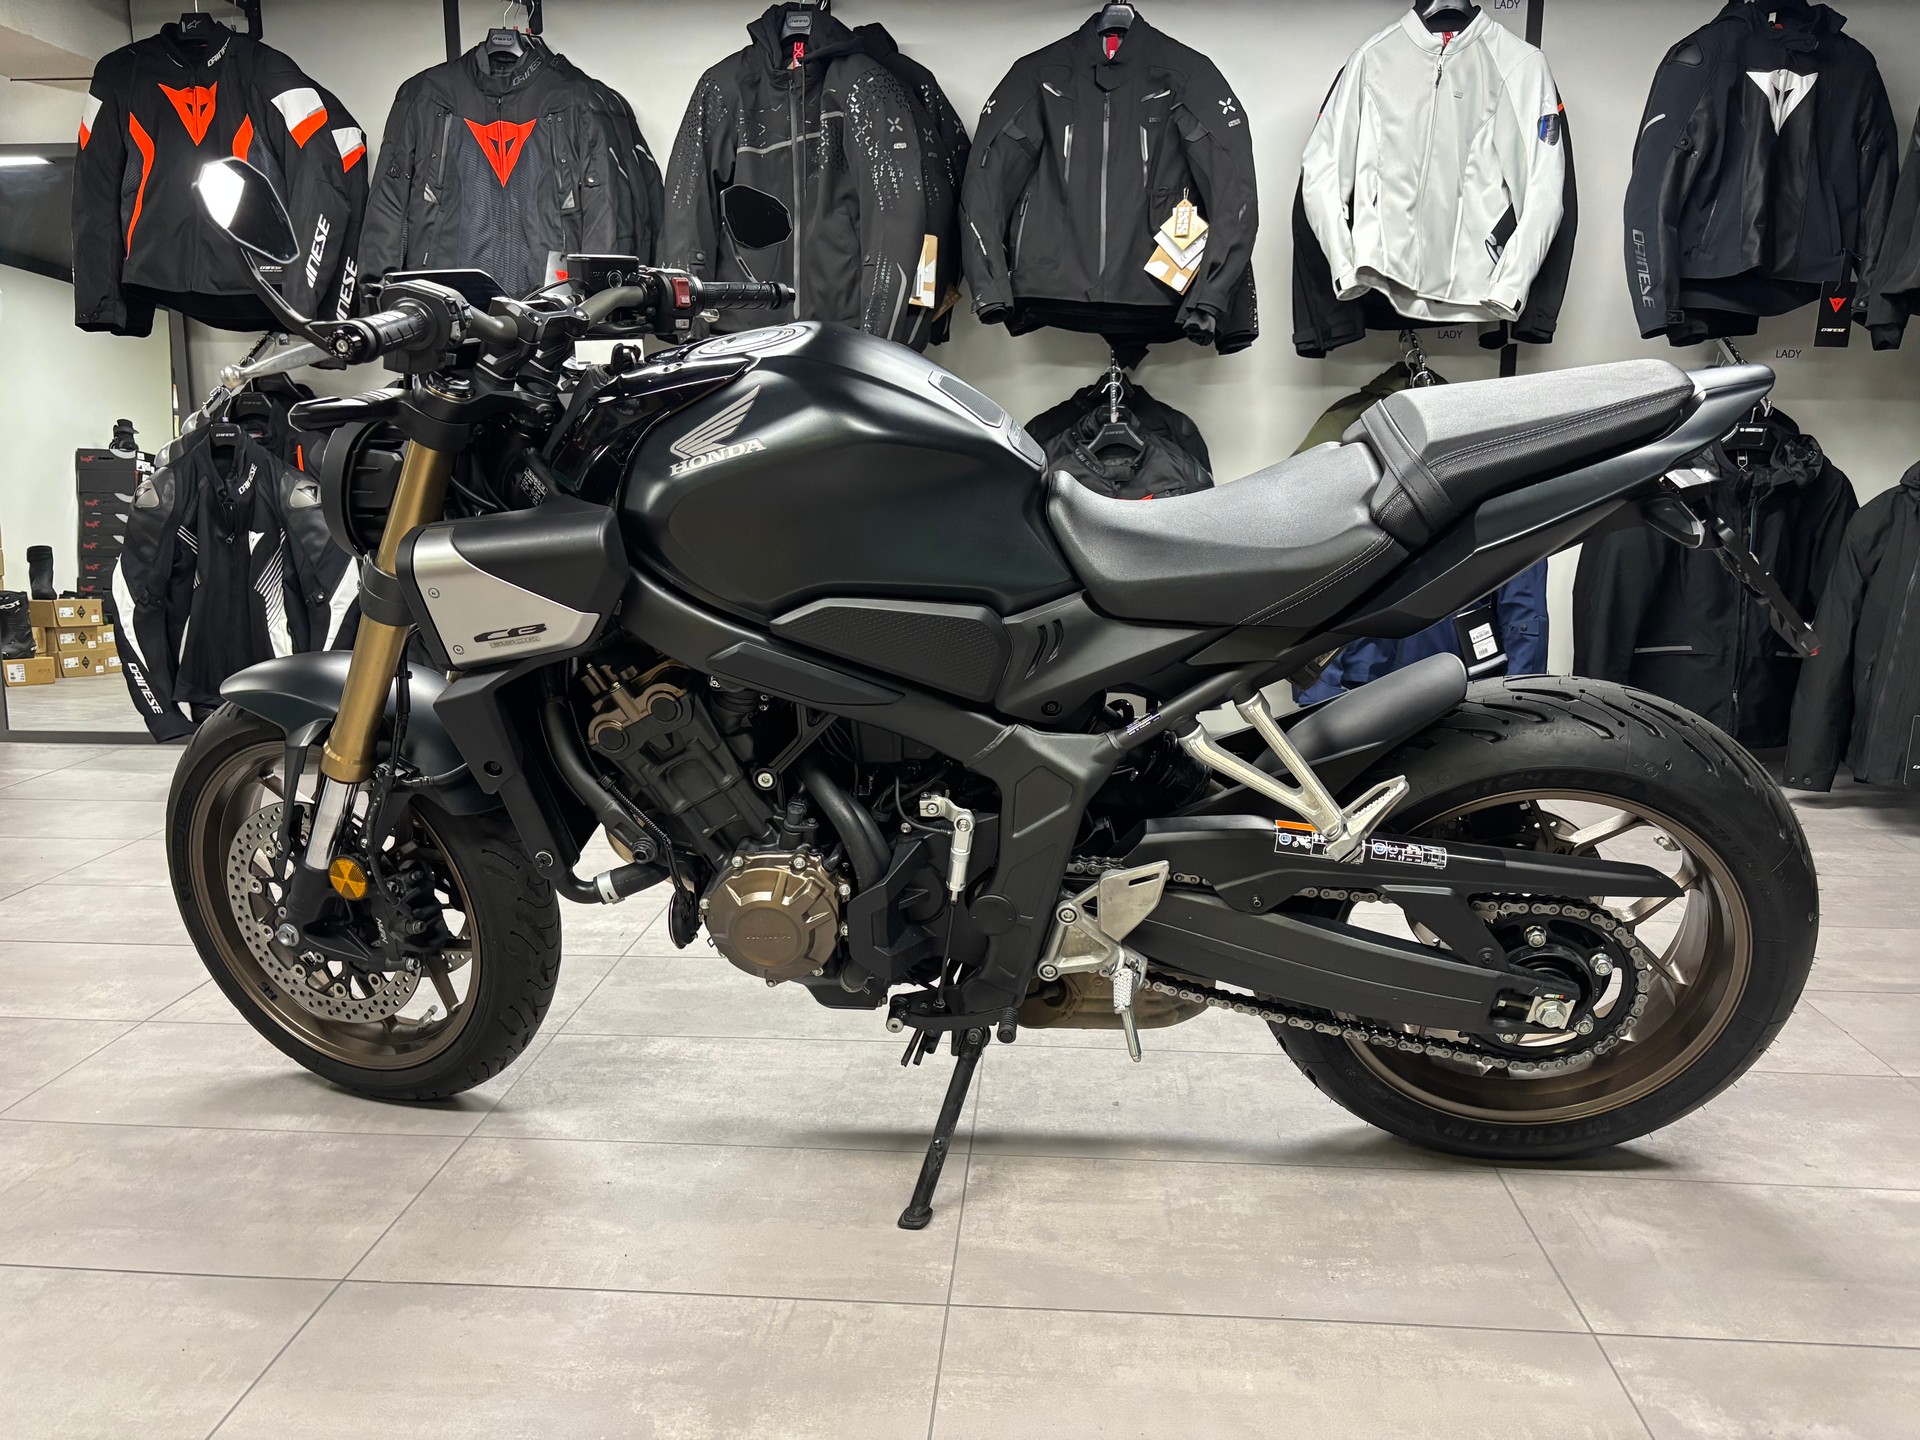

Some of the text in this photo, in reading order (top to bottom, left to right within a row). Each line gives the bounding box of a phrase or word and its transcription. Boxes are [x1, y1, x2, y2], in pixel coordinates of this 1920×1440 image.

[1494, 0, 1520, 9] LADY
[1632, 228, 1656, 309] DAINESE
[1437, 329, 1463, 339] LADY
[1775, 349, 1802, 359] LADY
[669, 438, 767, 477] HONDA
[238, 462, 258, 495] DAINESE
[473, 623, 547, 643] CB
[127, 662, 164, 714] DAINESE
